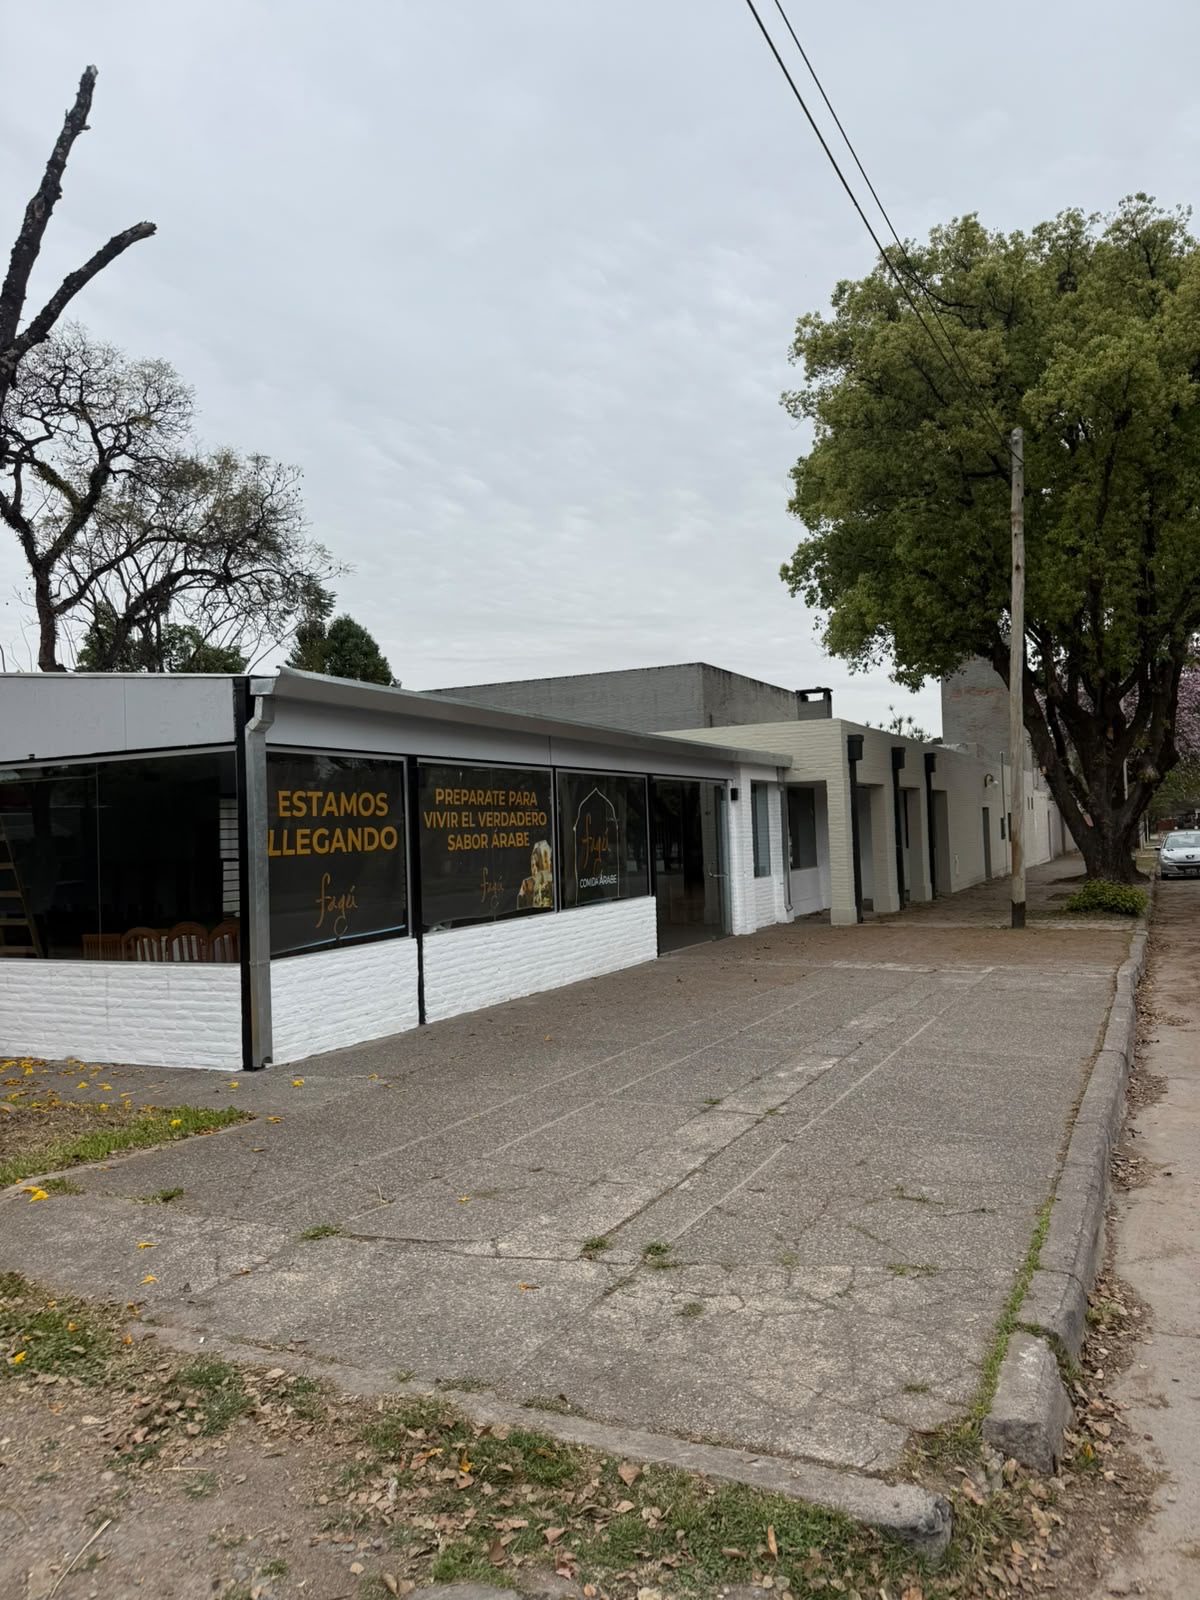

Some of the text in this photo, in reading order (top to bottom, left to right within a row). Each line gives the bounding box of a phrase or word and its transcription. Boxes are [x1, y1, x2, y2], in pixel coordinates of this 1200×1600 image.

[278, 790, 389, 817] ESTAMOS
[435, 788, 538, 807] PREPARATE PARA
[424, 811, 548, 829] VIVIR EL VERDADERO
[268, 825, 399, 857] LLEGANDO
[447, 827, 530, 852] SABOR ÁRABE
[579, 877, 599, 889] COMIDA
